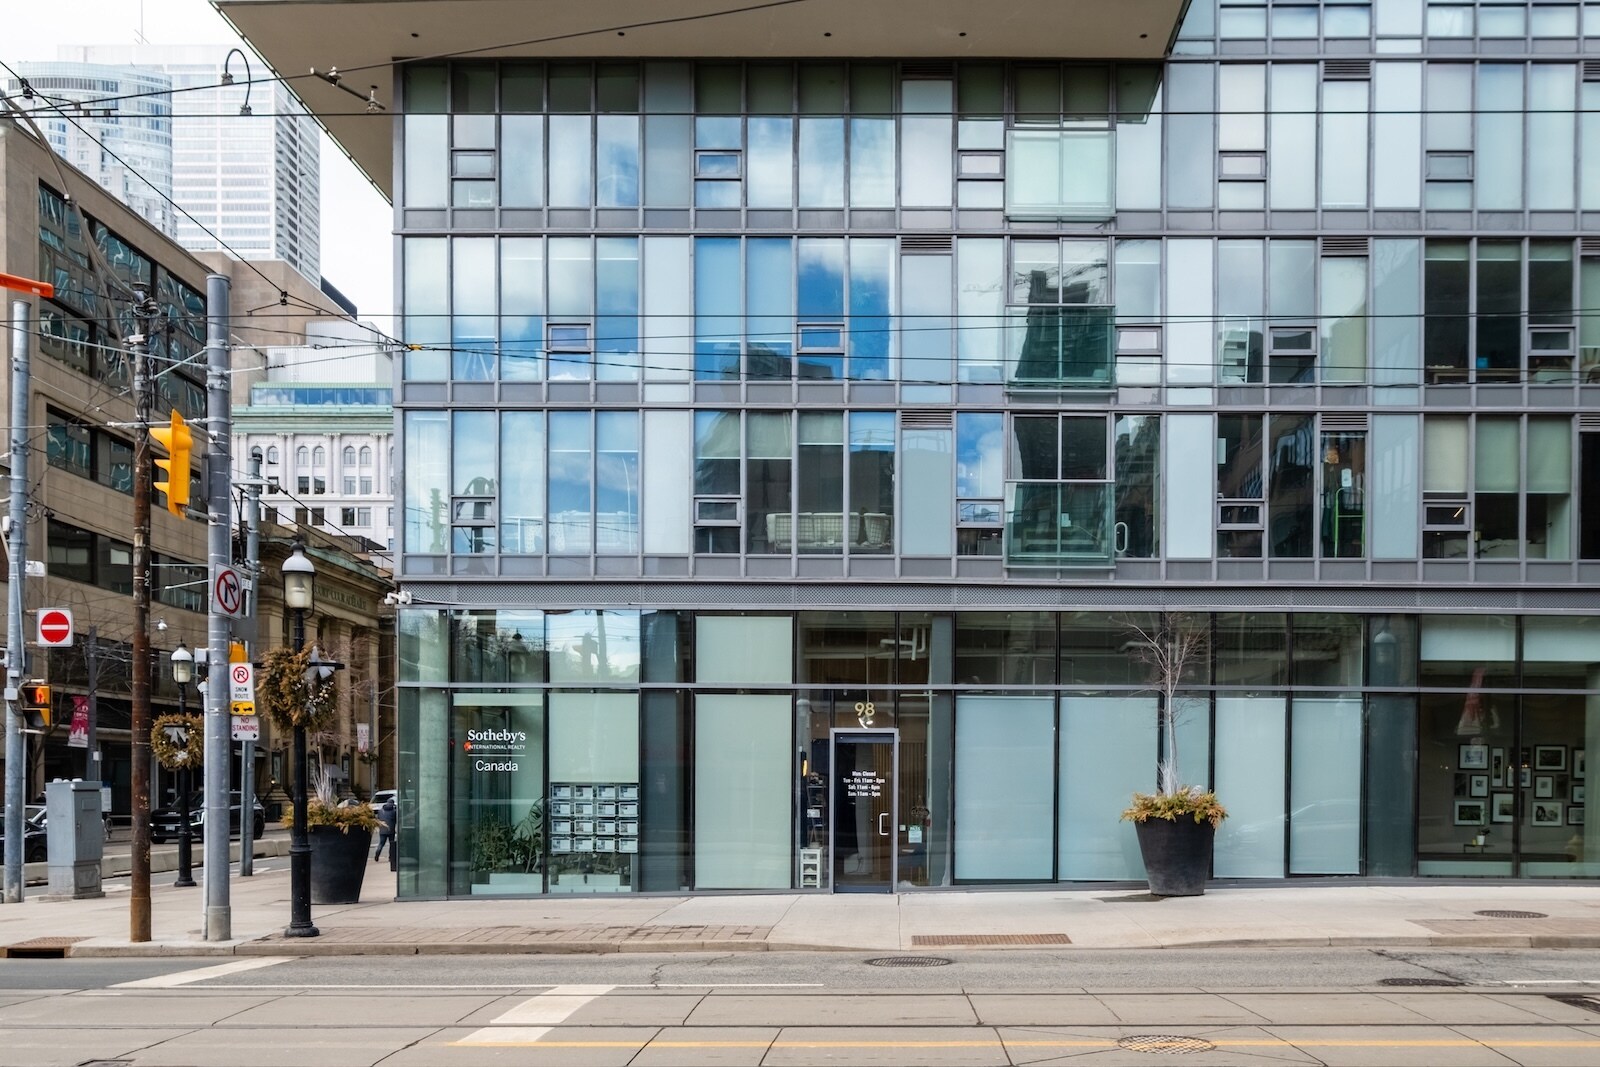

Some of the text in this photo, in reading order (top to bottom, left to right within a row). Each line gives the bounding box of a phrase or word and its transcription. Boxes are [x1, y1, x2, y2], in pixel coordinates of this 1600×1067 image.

[854, 702, 875, 717] 98
[467, 728, 526, 744] Sotheby's
[475, 759, 519, 771] Canada
